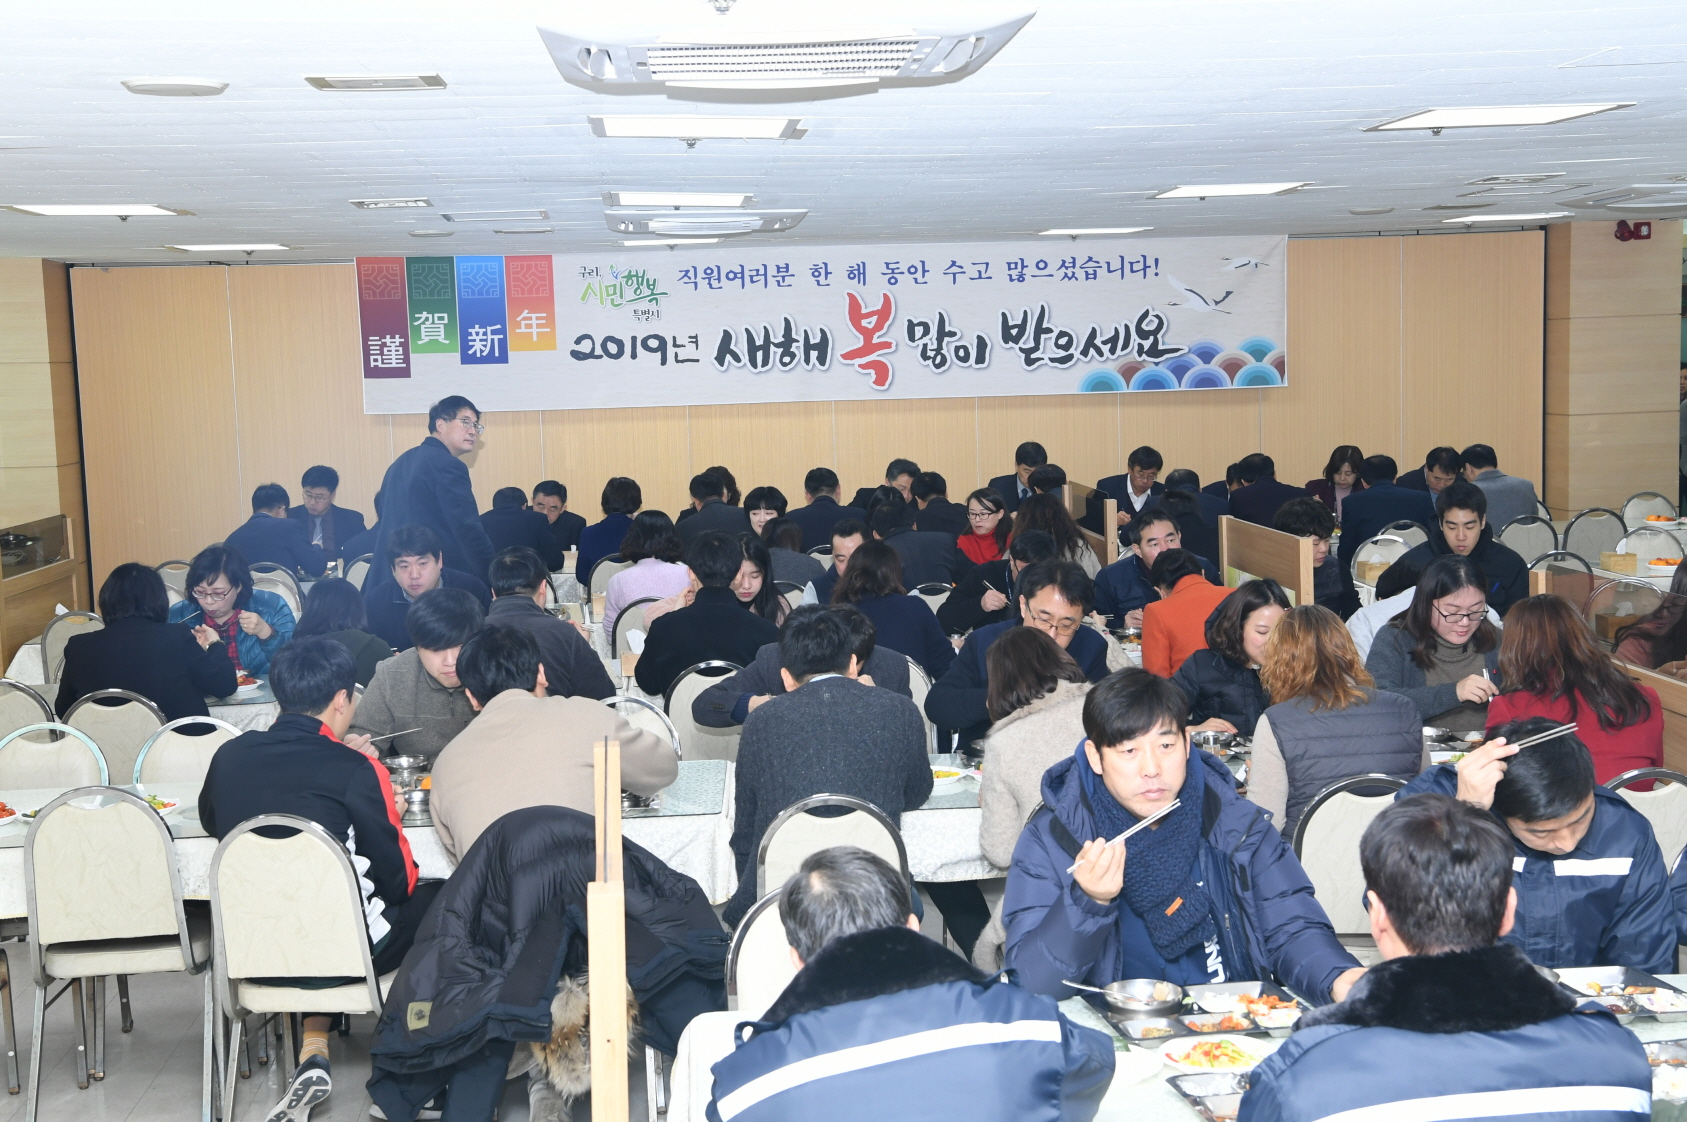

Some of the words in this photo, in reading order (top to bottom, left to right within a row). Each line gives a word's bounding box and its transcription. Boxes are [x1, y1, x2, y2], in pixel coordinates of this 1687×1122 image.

[580, 269, 669, 308] 시민행복
[677, 263, 796, 291] 직원여러분
[809, 261, 833, 287] 한
[846, 261, 867, 287] 해
[881, 259, 931, 286] 동안
[943, 259, 993, 286] 수고
[1006, 254, 1160, 283] 많으셨습니다!
[632, 308, 660, 322] 특별시
[569, 333, 701, 367] 2019년
[714, 316, 830, 370] 새해
[839, 292, 895, 387] 복
[907, 311, 988, 370] 많이
[1000, 304, 1188, 367] 받으세요
